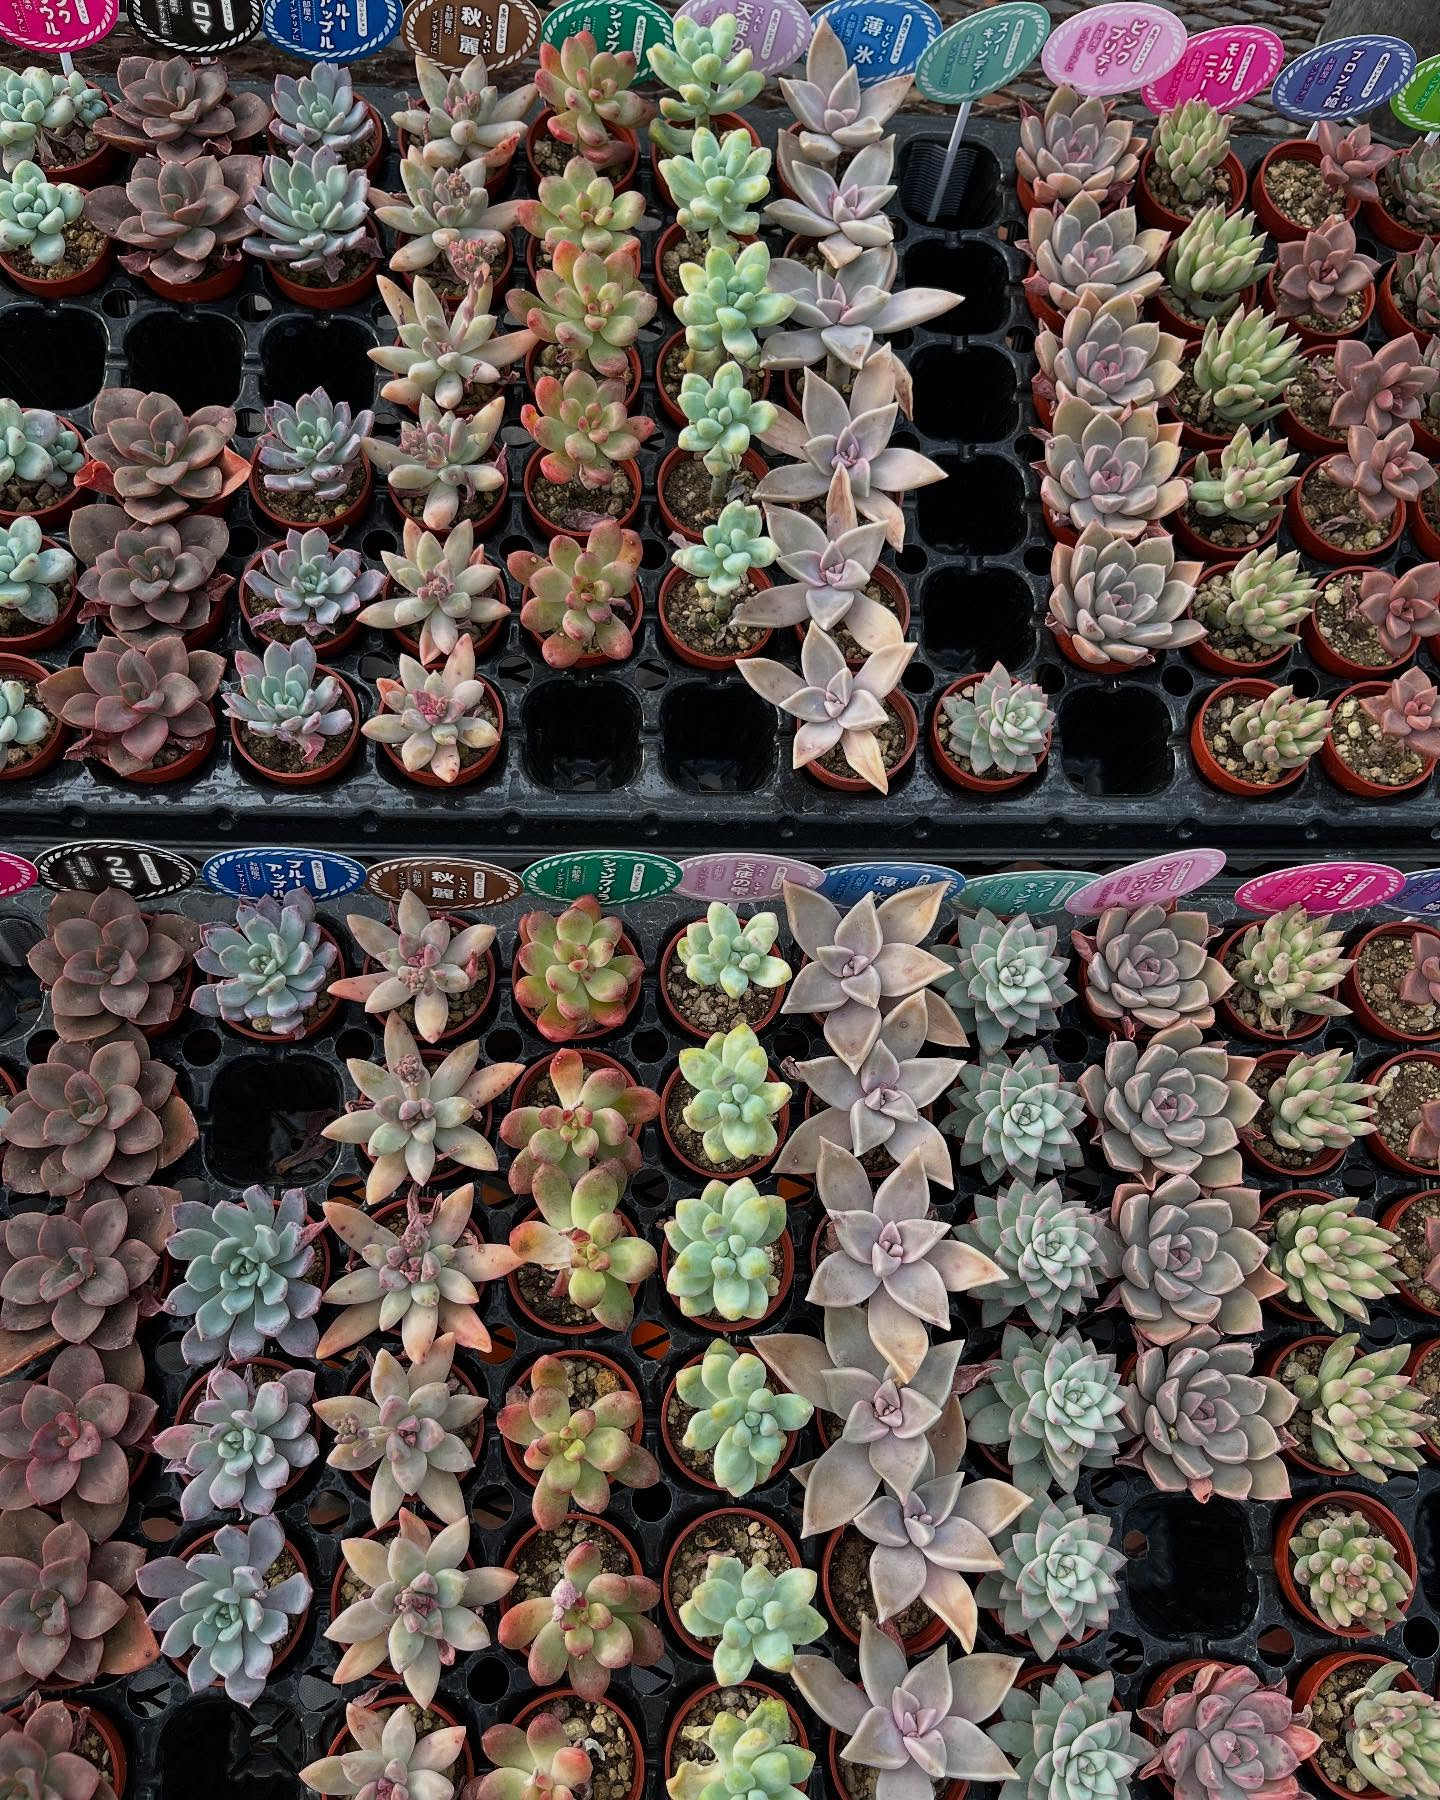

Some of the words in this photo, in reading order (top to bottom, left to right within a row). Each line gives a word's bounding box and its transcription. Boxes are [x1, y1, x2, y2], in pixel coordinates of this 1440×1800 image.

[335, 0, 351, 31] ルー
[994, 22, 1019, 55] スノー
[970, 27, 995, 88] キャンディー
[1216, 42, 1240, 84] モルガ
